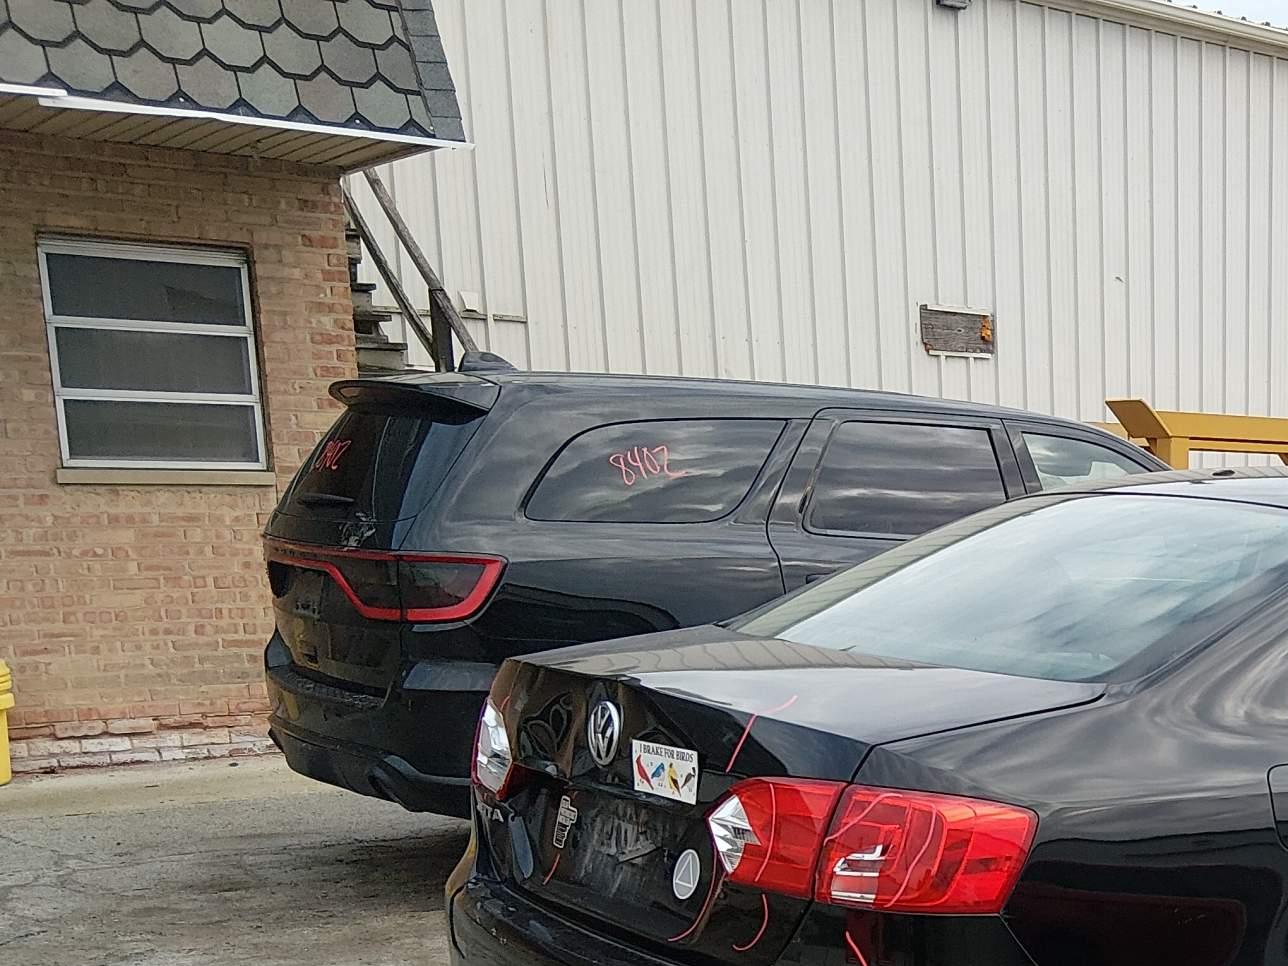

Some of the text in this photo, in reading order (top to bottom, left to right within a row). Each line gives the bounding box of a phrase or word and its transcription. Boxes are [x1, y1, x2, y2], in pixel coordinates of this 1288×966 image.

[609, 446, 689, 485] 8402
[643, 743, 663, 757] BRAKE
[663, 748, 675, 760] FOR
[676, 750, 694, 763] BIRDS
